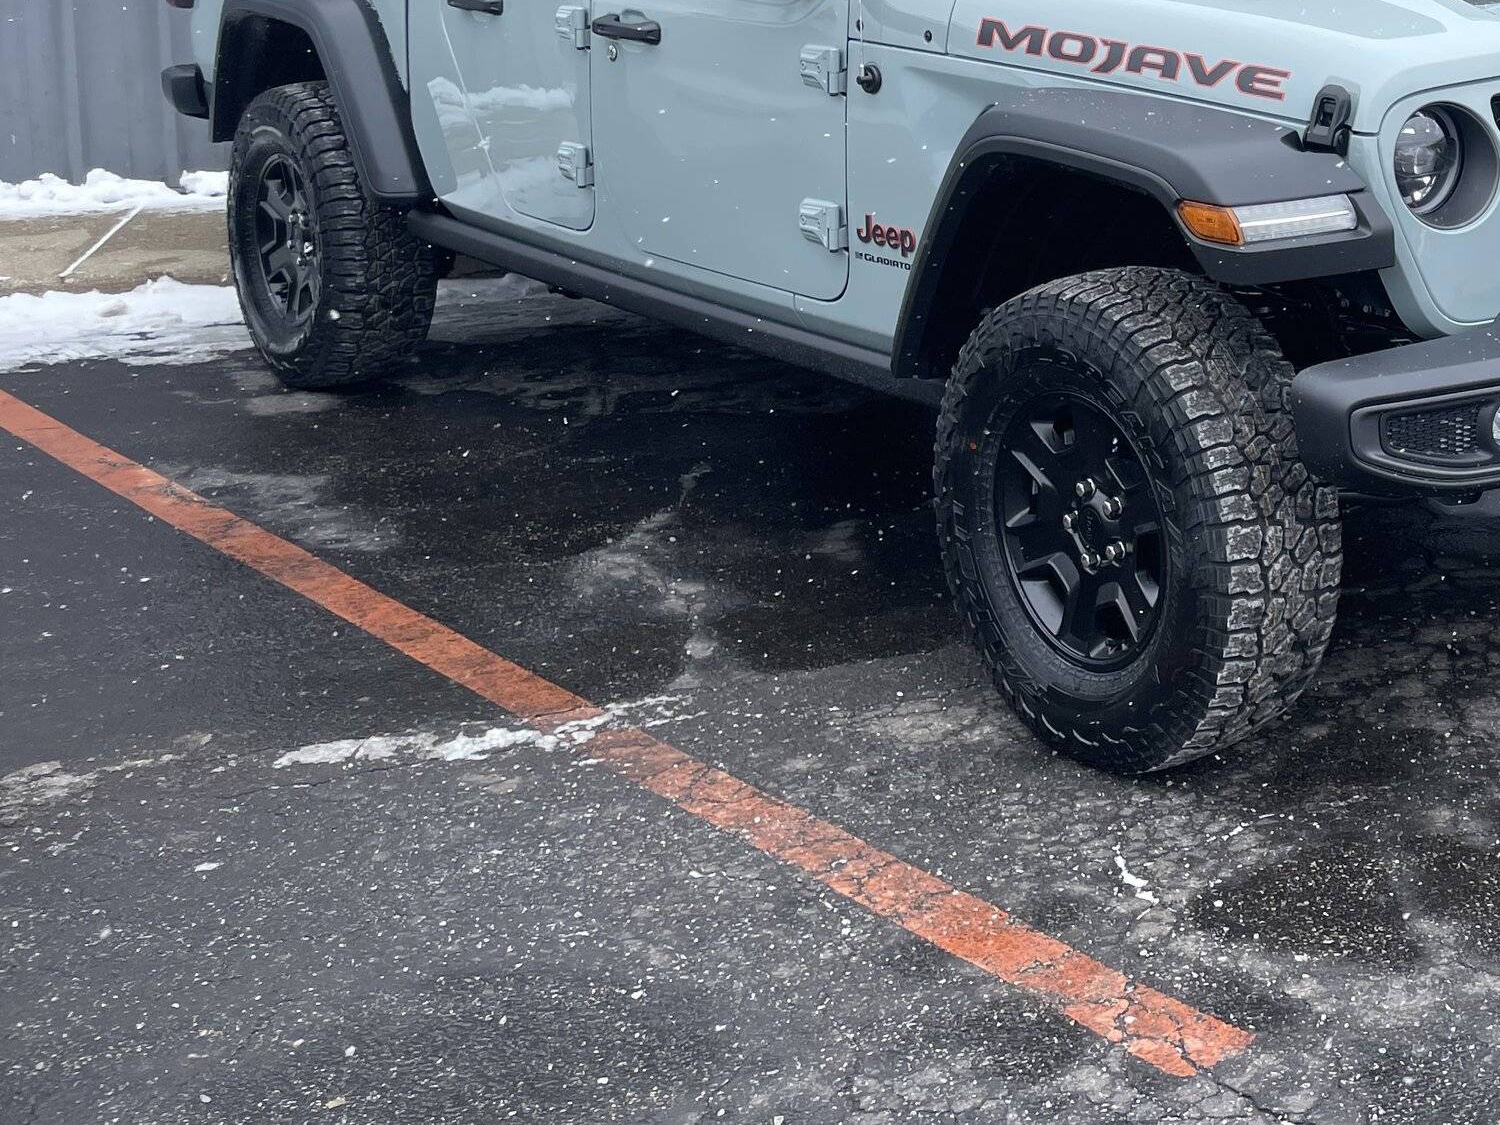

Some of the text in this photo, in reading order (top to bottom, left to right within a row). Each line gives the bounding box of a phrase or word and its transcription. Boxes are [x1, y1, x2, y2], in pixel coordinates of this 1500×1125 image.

[976, 16, 1291, 101] MOJAVE
[856, 212, 916, 258] Jeep
[864, 253, 913, 271] GLADIATO
